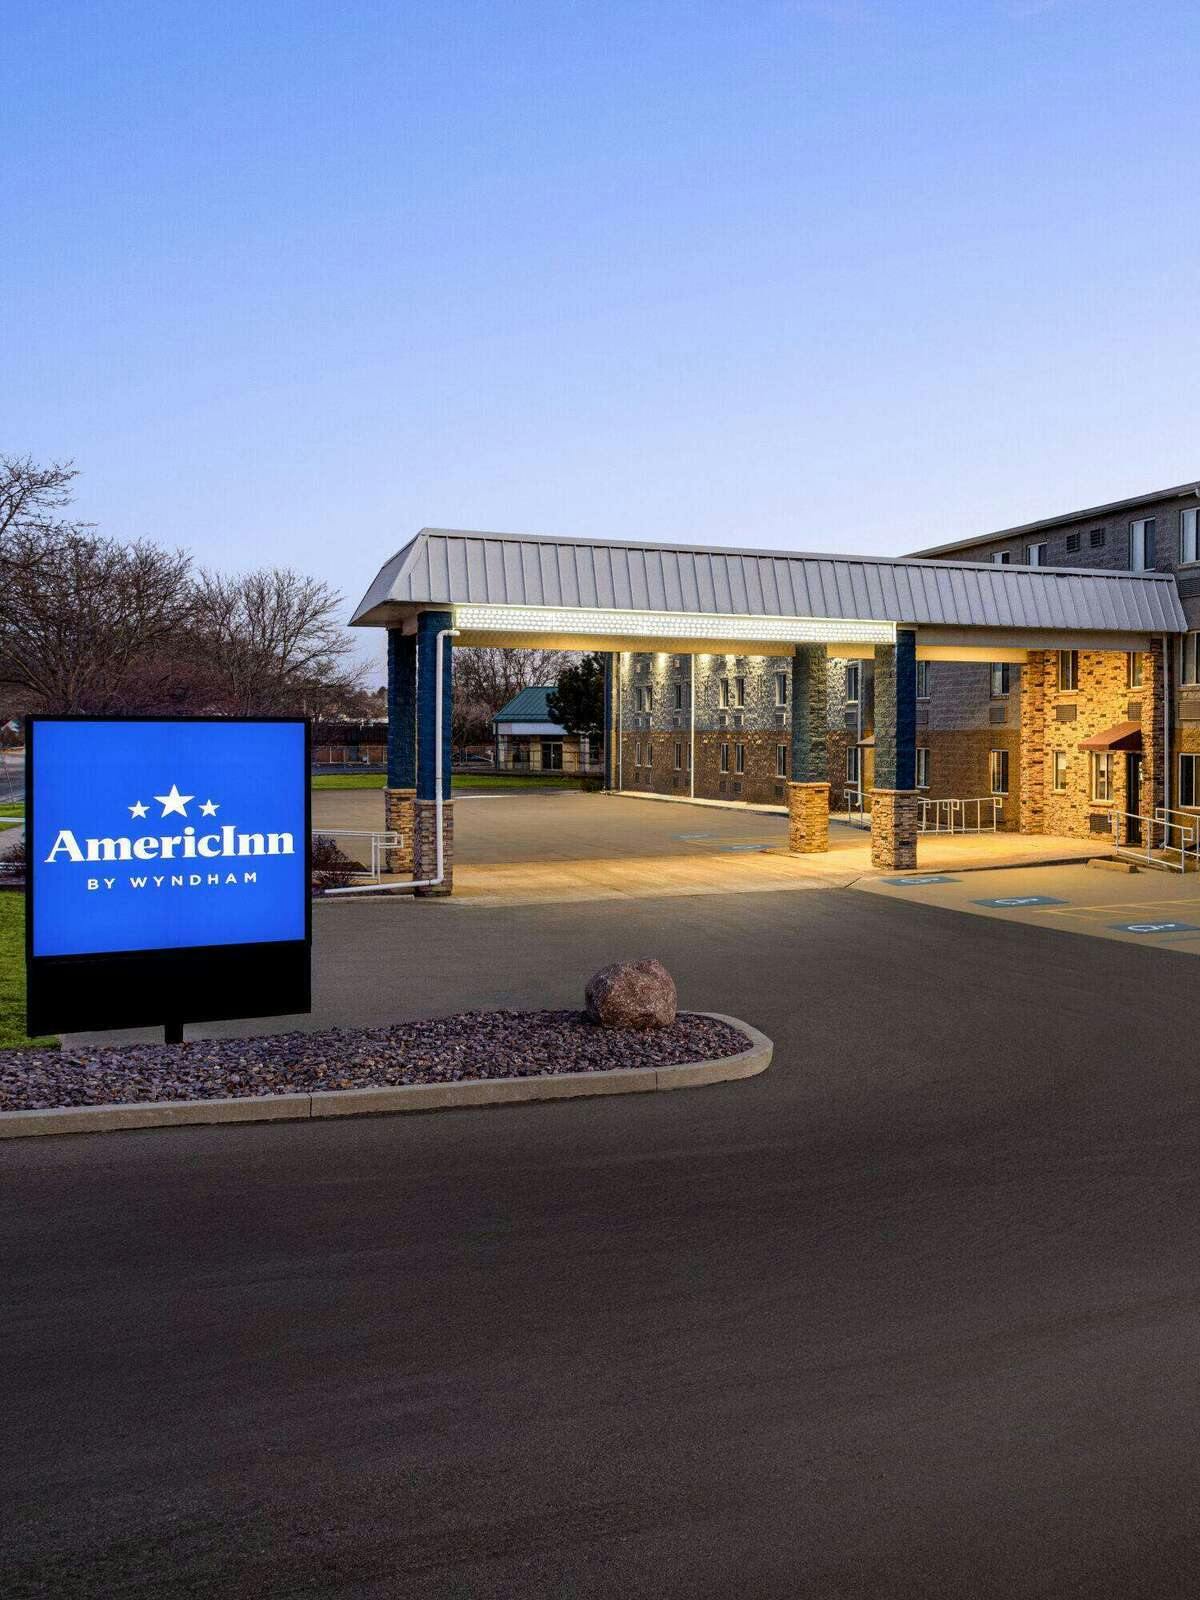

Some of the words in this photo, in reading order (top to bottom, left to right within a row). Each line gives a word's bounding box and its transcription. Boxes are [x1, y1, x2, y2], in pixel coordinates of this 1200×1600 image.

[44, 825, 296, 863] AmericInn
[88, 878, 116, 890] BY
[130, 872, 258, 889] WYNDHAM
